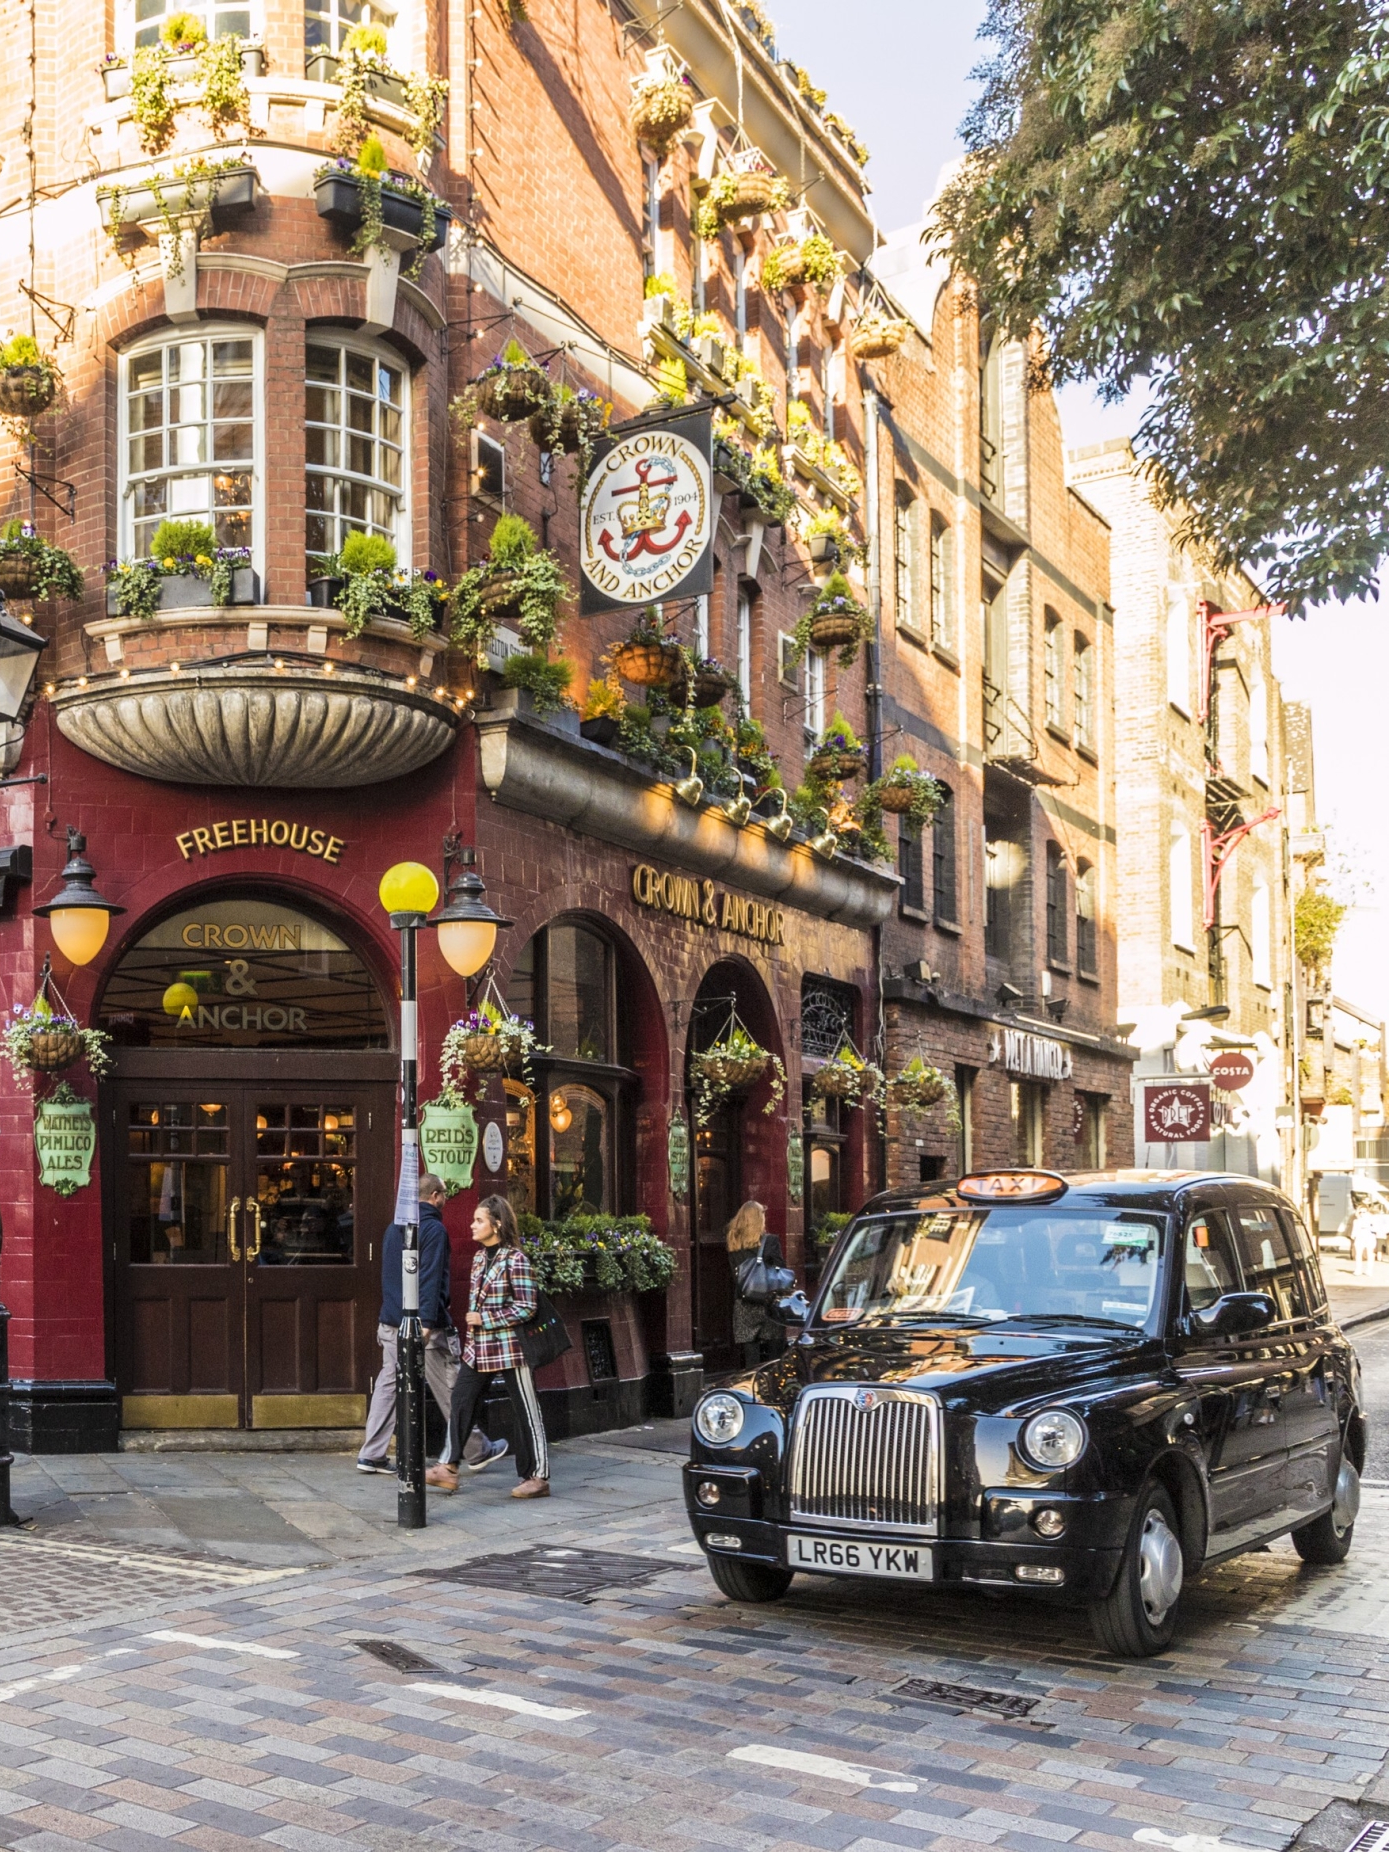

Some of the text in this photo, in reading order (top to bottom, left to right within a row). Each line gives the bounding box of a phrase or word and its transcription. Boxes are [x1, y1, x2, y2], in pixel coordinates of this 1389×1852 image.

[605, 435, 684, 474] CROWN
[673, 491, 699, 506] 1904
[592, 511, 616, 526] EST.
[584, 538, 704, 599] AND ANCHOR
[175, 818, 345, 864] FREEHOUSE
[633, 863, 786, 947] CROWN & ANCHOR
[181, 922, 302, 950] CROWN
[224, 958, 258, 997] &
[176, 1005, 308, 1032] ANCHOR
[1212, 1066, 1250, 1077] COSTA
[1148, 1089, 1205, 1113] ORGANIC COFFEE
[42, 1112, 92, 1132] WATNEY'S
[1151, 1119, 1204, 1139] NATURAL FOOD
[39, 1135, 92, 1151] PIMLICO
[426, 1124, 475, 1144] REID'S
[47, 1155, 83, 1170] ALES
[427, 1149, 474, 1165] STOUT
[975, 1178, 1037, 1193] TAXI
[797, 1539, 919, 1573] LR66 YKW
